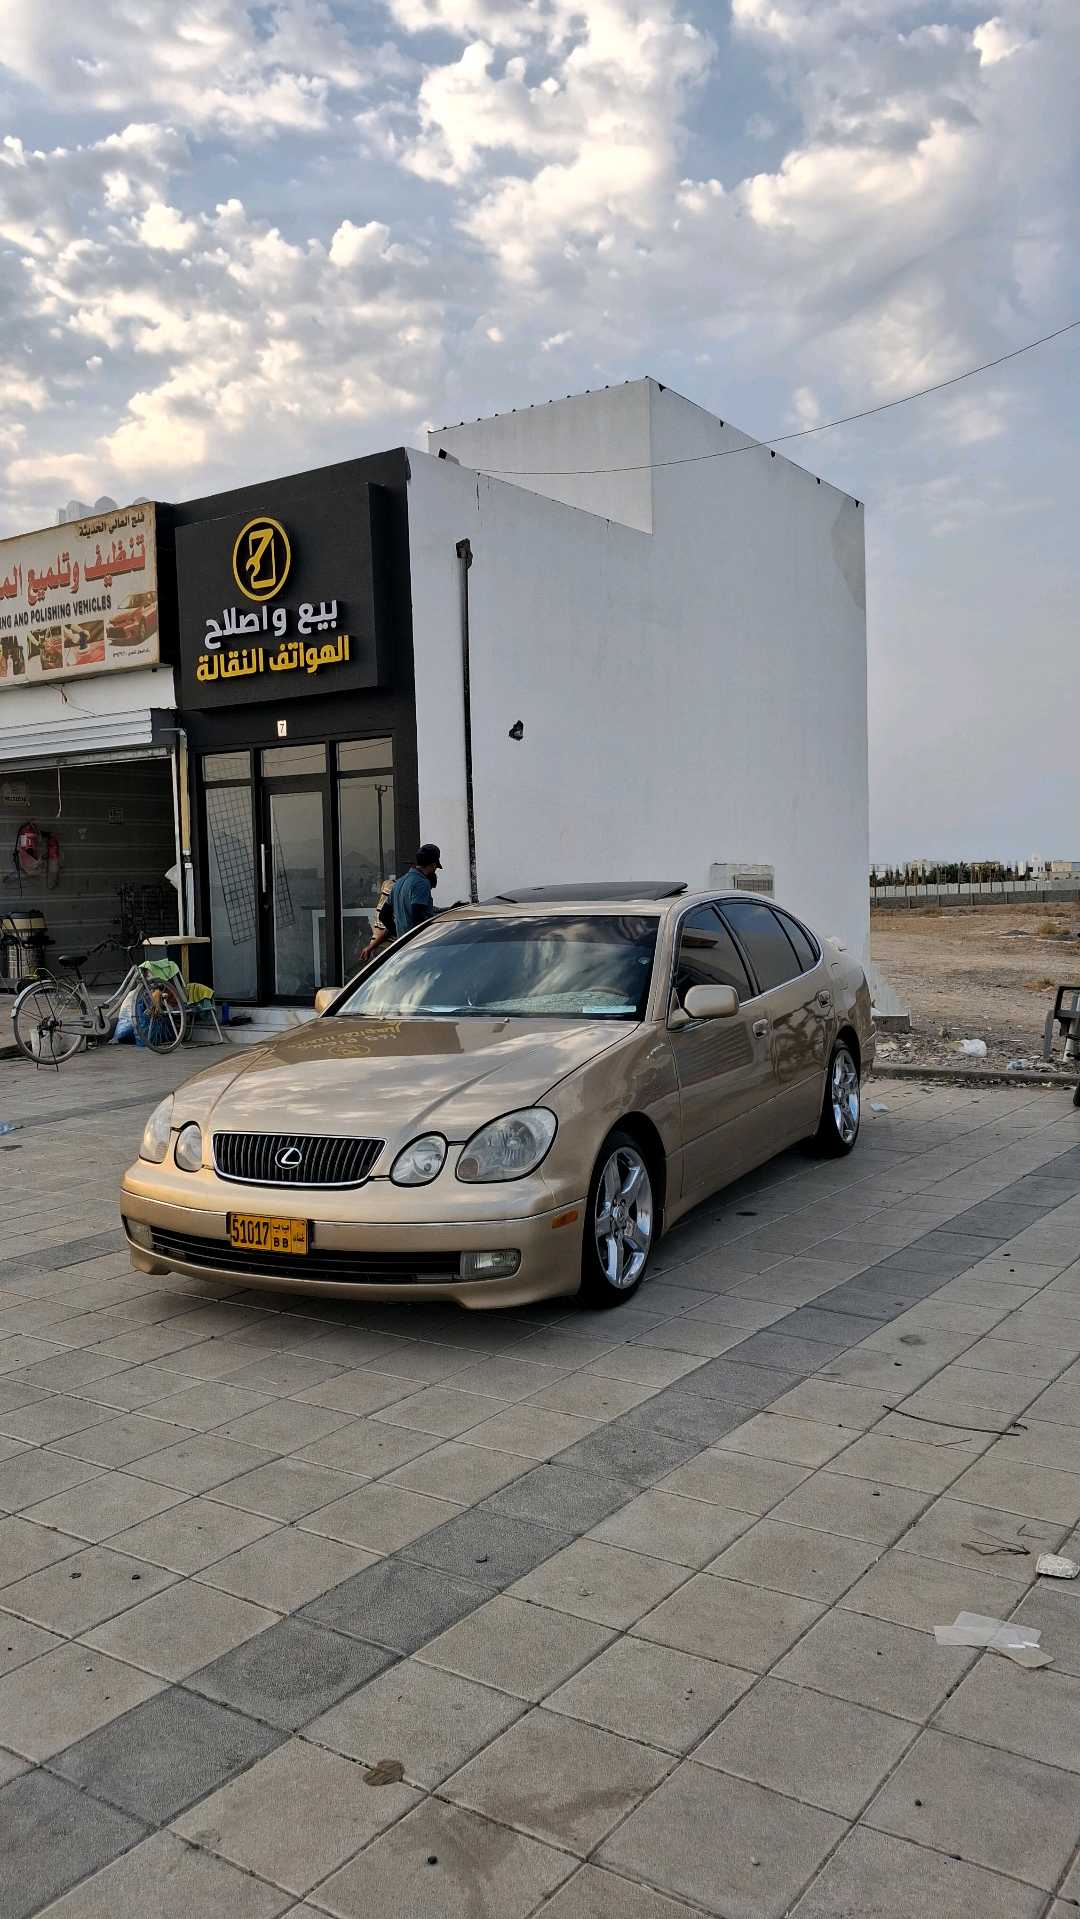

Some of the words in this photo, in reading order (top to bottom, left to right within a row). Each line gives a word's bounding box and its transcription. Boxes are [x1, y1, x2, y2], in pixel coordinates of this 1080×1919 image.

[28, 551, 80, 606] وتلميع
[84, 534, 146, 588] تنظيف
[14, 611, 29, 627] AND
[31, 603, 71, 624] POLISHING
[73, 594, 112, 616] VEHICLES
[298, 599, 338, 635] بيع
[196, 647, 264, 682] النقالة
[269, 634, 350, 673] الهواتف
[232, 1218, 269, 1246] 51017
